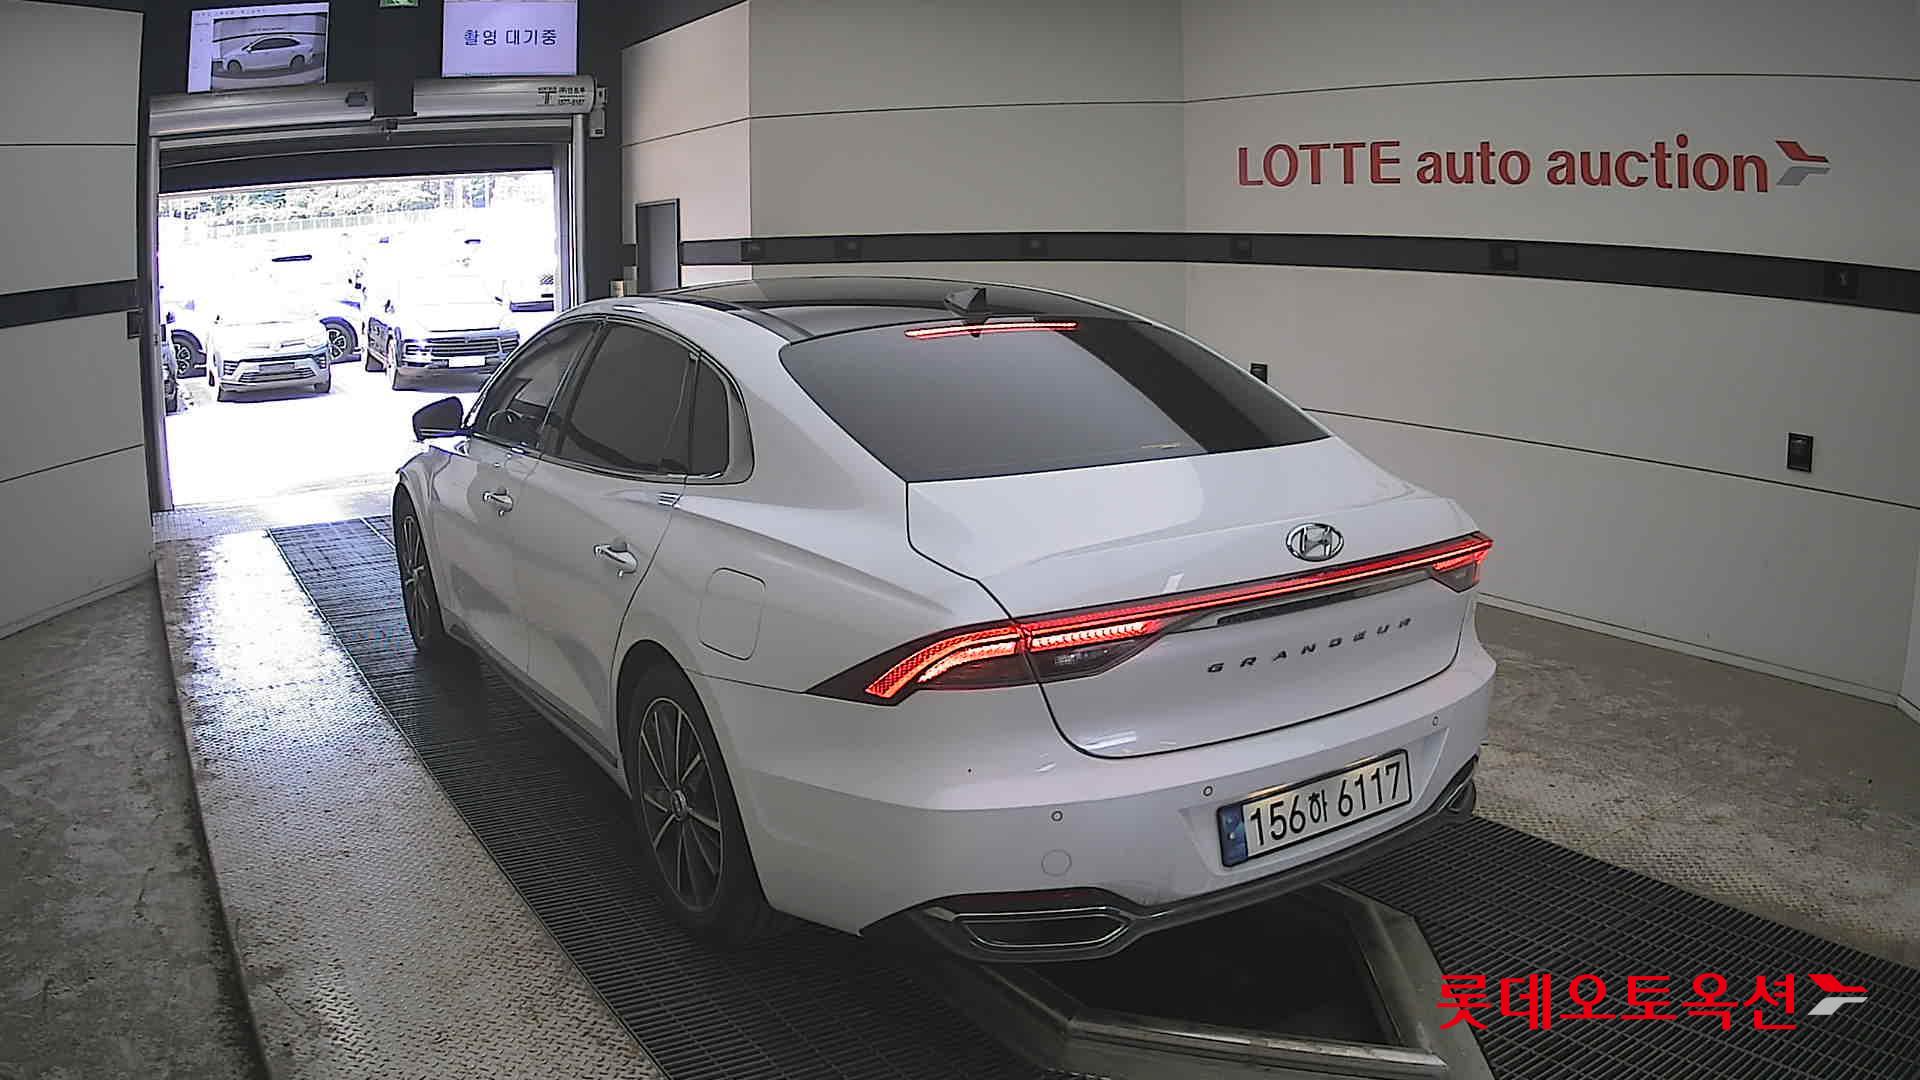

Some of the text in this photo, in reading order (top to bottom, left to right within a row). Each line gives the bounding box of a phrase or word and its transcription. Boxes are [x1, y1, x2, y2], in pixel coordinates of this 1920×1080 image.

[505, 29, 557, 46] 대기중
[1239, 134, 1768, 192] LOTTE auto auction
[1207, 617, 1412, 674] GRANDEUR
[1250, 761, 1401, 846] 156하 6117
